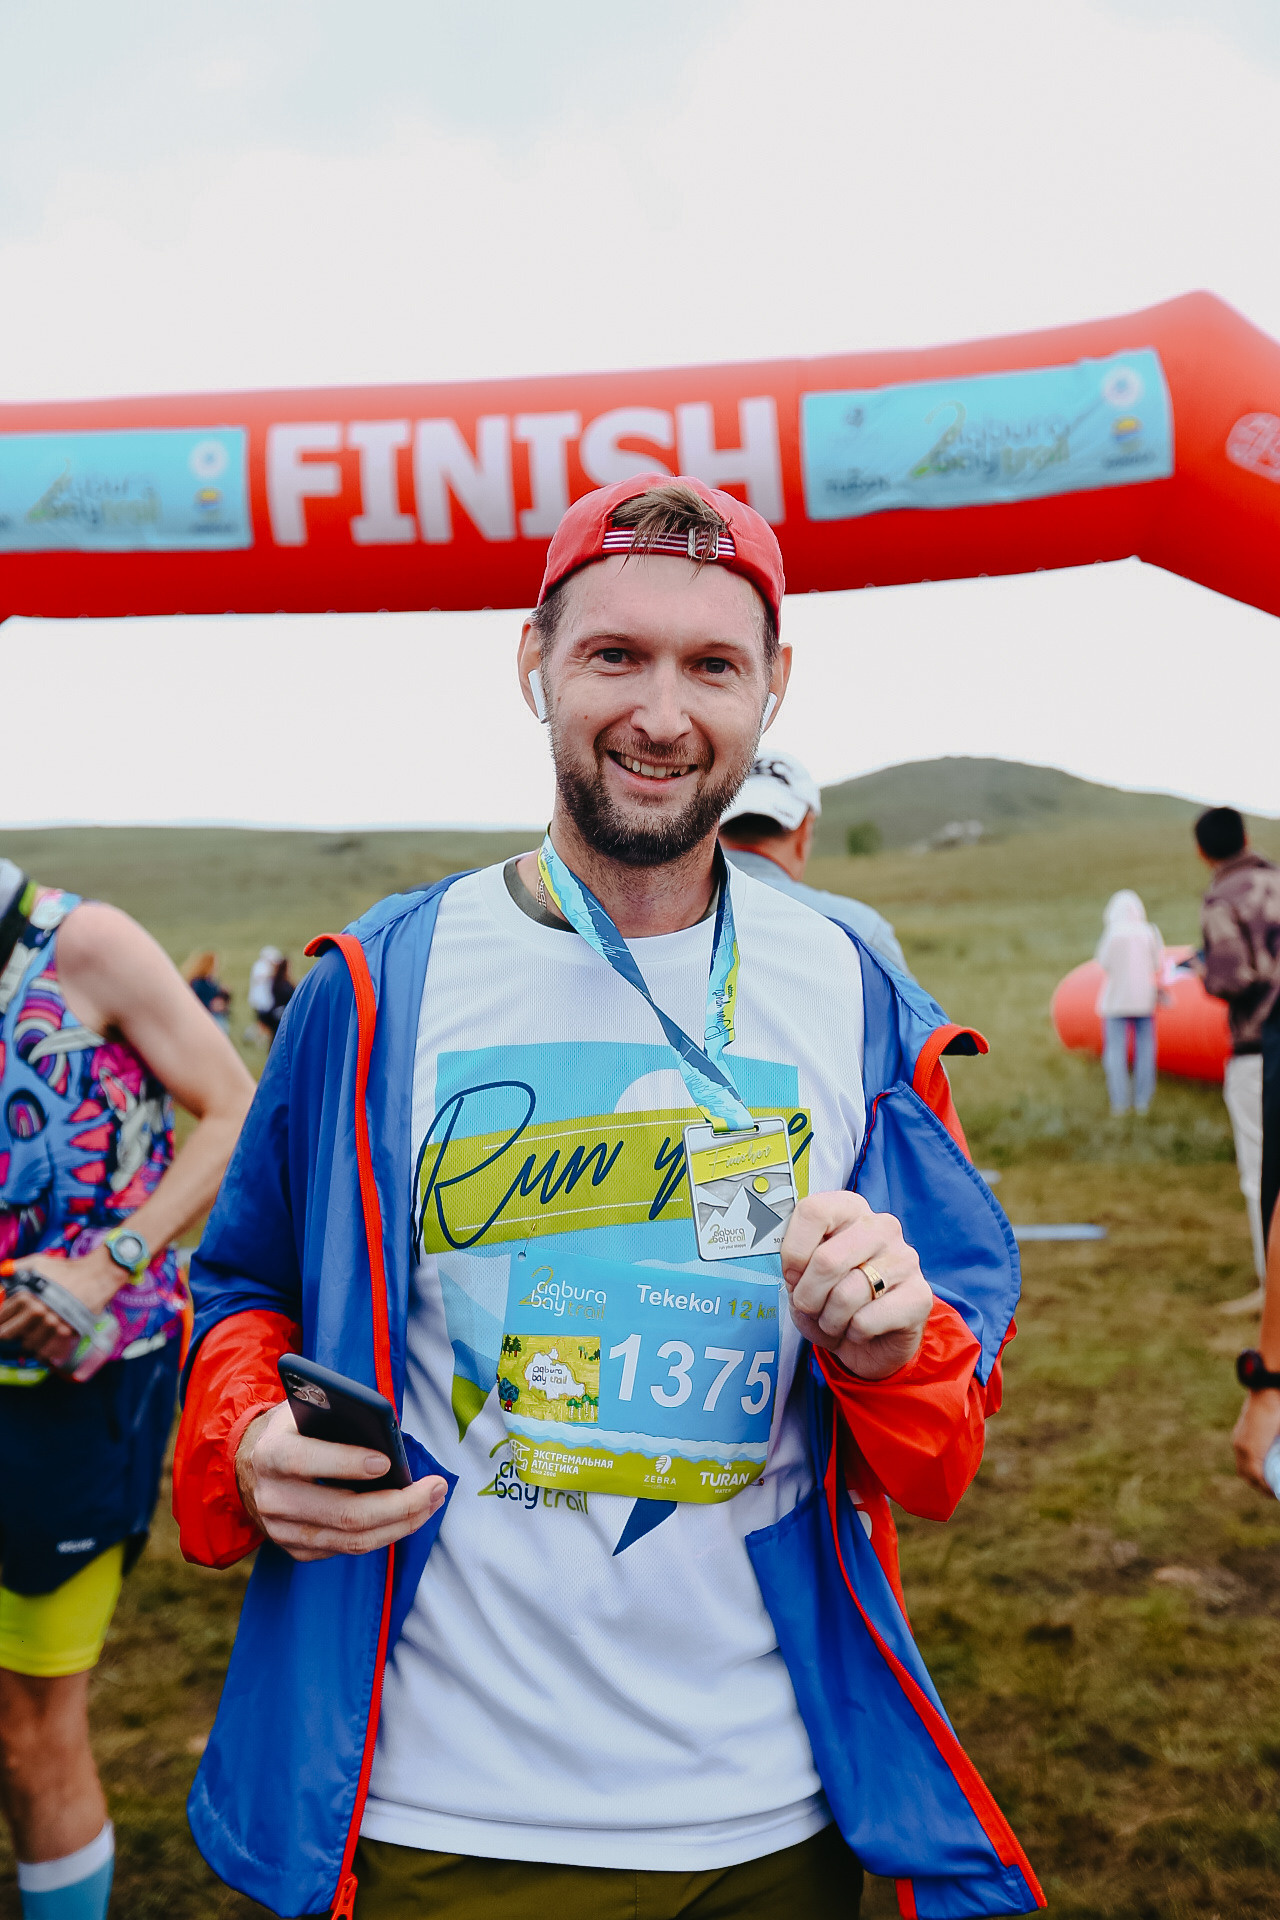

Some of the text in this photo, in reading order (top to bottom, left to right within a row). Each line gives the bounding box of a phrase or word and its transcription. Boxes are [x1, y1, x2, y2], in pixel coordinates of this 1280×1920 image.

[265, 396, 786, 546] FINISH
[411, 1081, 625, 1265] Run
[706, 1142, 772, 1178] Finisher
[530, 1289, 606, 1321] bay trail
[636, 1283, 777, 1320] Tekekol 12 km
[608, 1333, 776, 1415] 1375
[531, 1460, 579, 1475] АТЛЕТИКА
[533, 1449, 614, 1469] ЭКСТРЕМАЛЬНАЯ
[494, 1473, 589, 1515] bay trail
[643, 1474, 677, 1486] ZEBRA
[700, 1471, 750, 1487] TURAN
